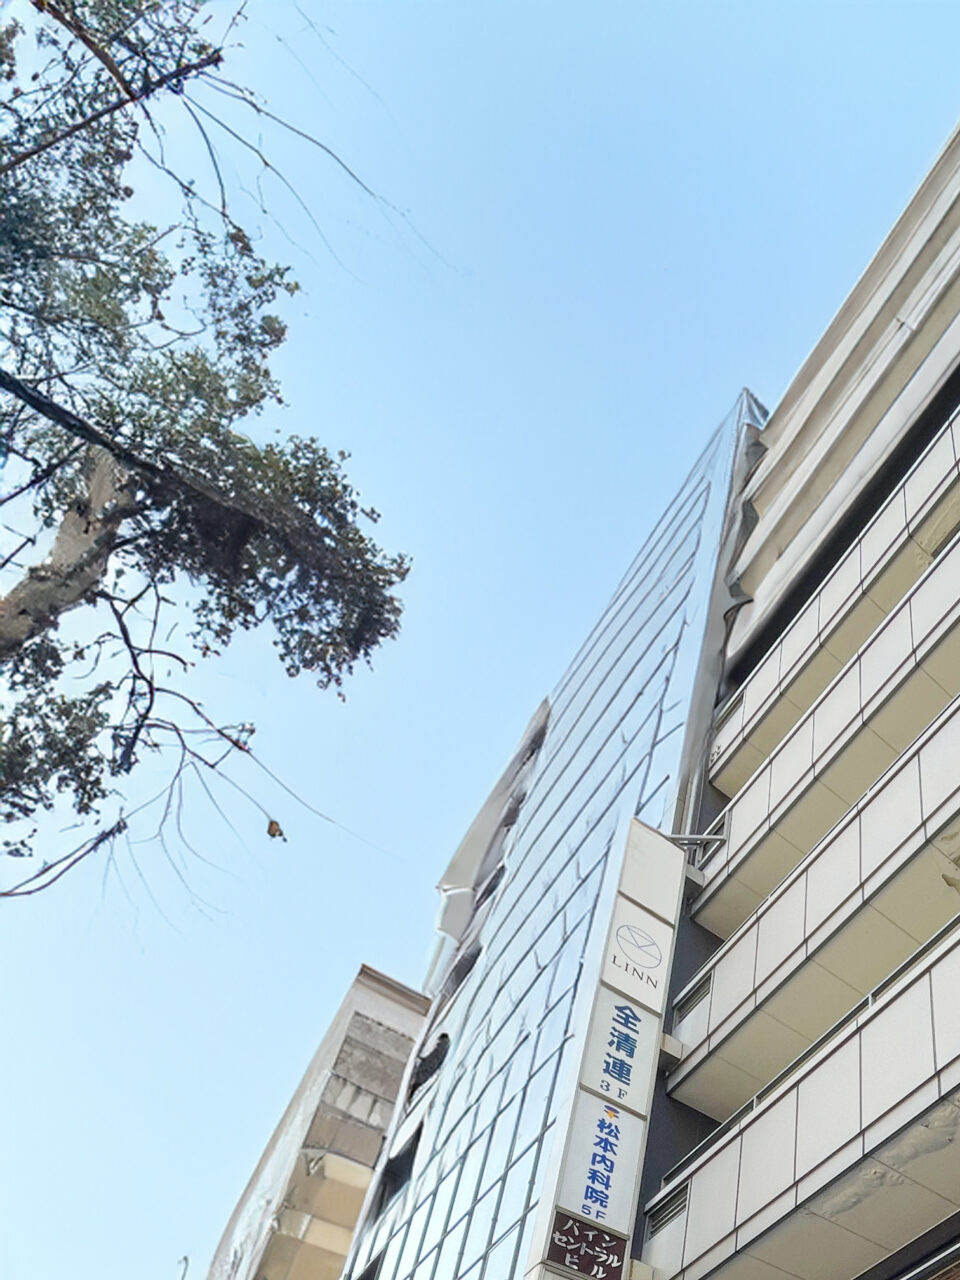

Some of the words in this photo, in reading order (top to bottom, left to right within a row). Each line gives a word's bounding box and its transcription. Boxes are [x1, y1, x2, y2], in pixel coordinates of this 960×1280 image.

[611, 954, 660, 990] LINN
[602, 1004, 642, 1087] 全清連
[584, 1117, 620, 1209] 松本内科院
[552, 1231, 622, 1268] セントラル
[563, 1219, 616, 1248] パイン
[564, 1254, 608, 1279] ビル
